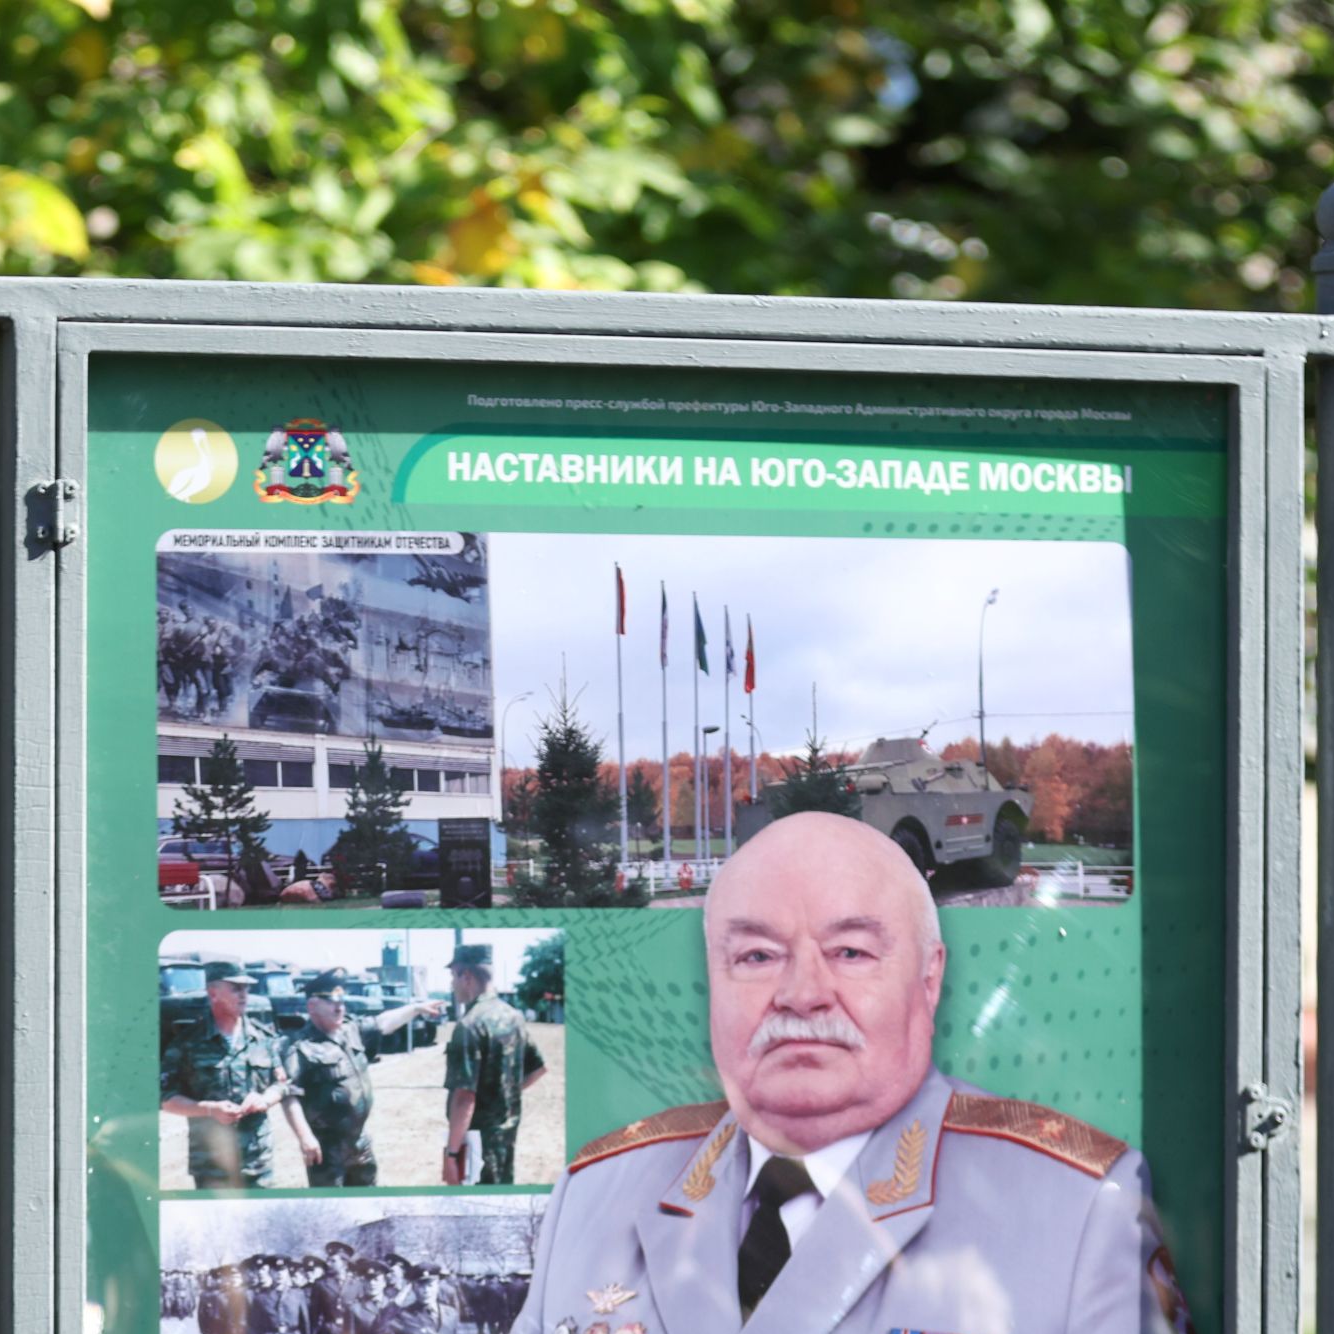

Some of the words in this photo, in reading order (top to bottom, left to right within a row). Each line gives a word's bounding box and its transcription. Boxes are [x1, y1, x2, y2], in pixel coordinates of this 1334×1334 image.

[467, 394, 562, 409] Подготовлено
[566, 397, 665, 412] пресс-службой
[667, 400, 749, 414] префектуры
[752, 400, 853, 416] Юго-Западного
[855, 402, 986, 418] Административного
[988, 407, 1031, 420] округа
[1034, 408, 1078, 421] города
[1080, 407, 1132, 421] Москвы
[447, 451, 683, 485] НАСТАВНИКИ
[694, 456, 742, 486] НА
[750, 457, 970, 496] ЮГО-ЗАПАДЕ
[979, 461, 1132, 494] МОСКВЫ
[173, 532, 261, 547] МЕМОРИАЛЬНЫЙ
[265, 535, 317, 548] КОМПЛЕКС
[322, 535, 392, 549] ЗАЩИТНИКАМ
[395, 536, 450, 549] ОТЕЧЕСТВА
